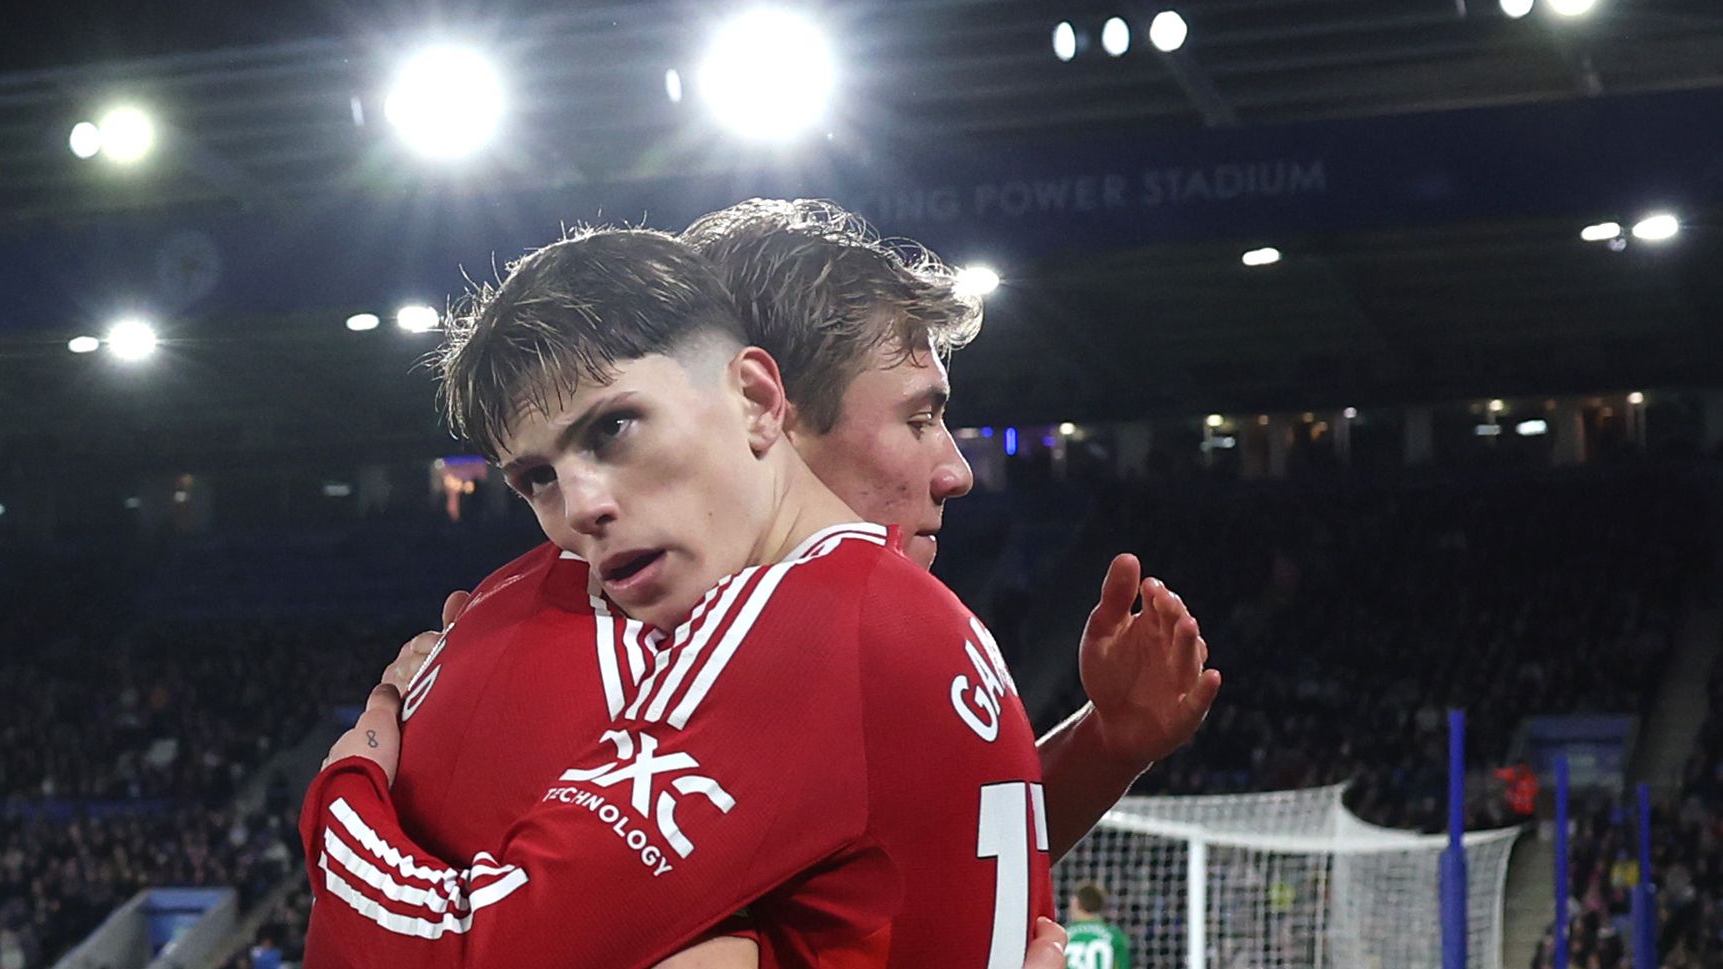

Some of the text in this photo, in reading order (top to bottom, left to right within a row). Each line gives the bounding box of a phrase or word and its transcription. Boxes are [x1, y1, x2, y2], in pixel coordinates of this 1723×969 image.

[974, 172, 1127, 216] POWER
[1142, 160, 1327, 207] STADIUM
[542, 786, 674, 877] TECHNOLOGY
